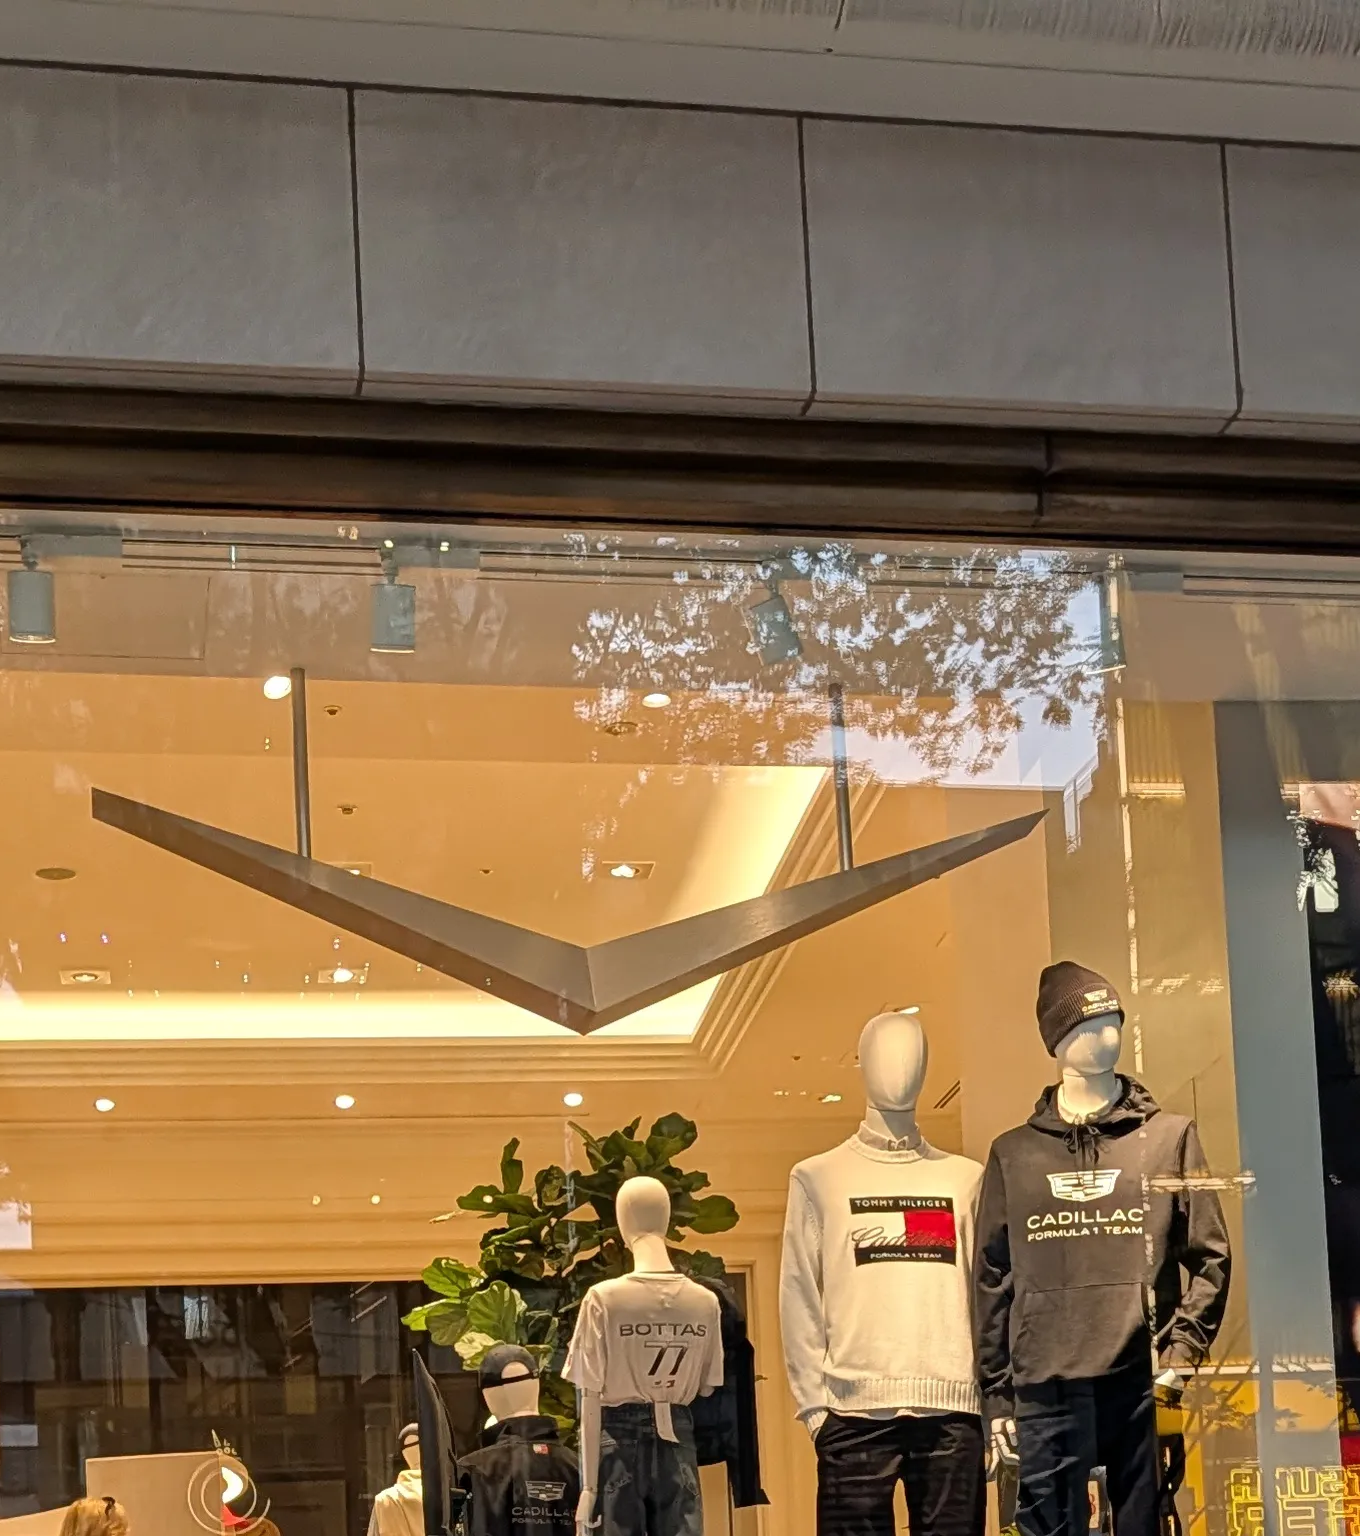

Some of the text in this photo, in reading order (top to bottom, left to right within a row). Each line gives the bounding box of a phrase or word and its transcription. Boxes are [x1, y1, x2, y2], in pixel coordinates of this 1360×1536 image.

[855, 1199, 947, 1208] TOMMY HILFIGER
[1026, 1208, 1144, 1229] CADILLAC
[1027, 1226, 1143, 1242] FORMULA 1 TEAM
[919, 1252, 942, 1260] TEAM
[620, 1323, 707, 1337] BOTTAS
[644, 1340, 688, 1376] 77
